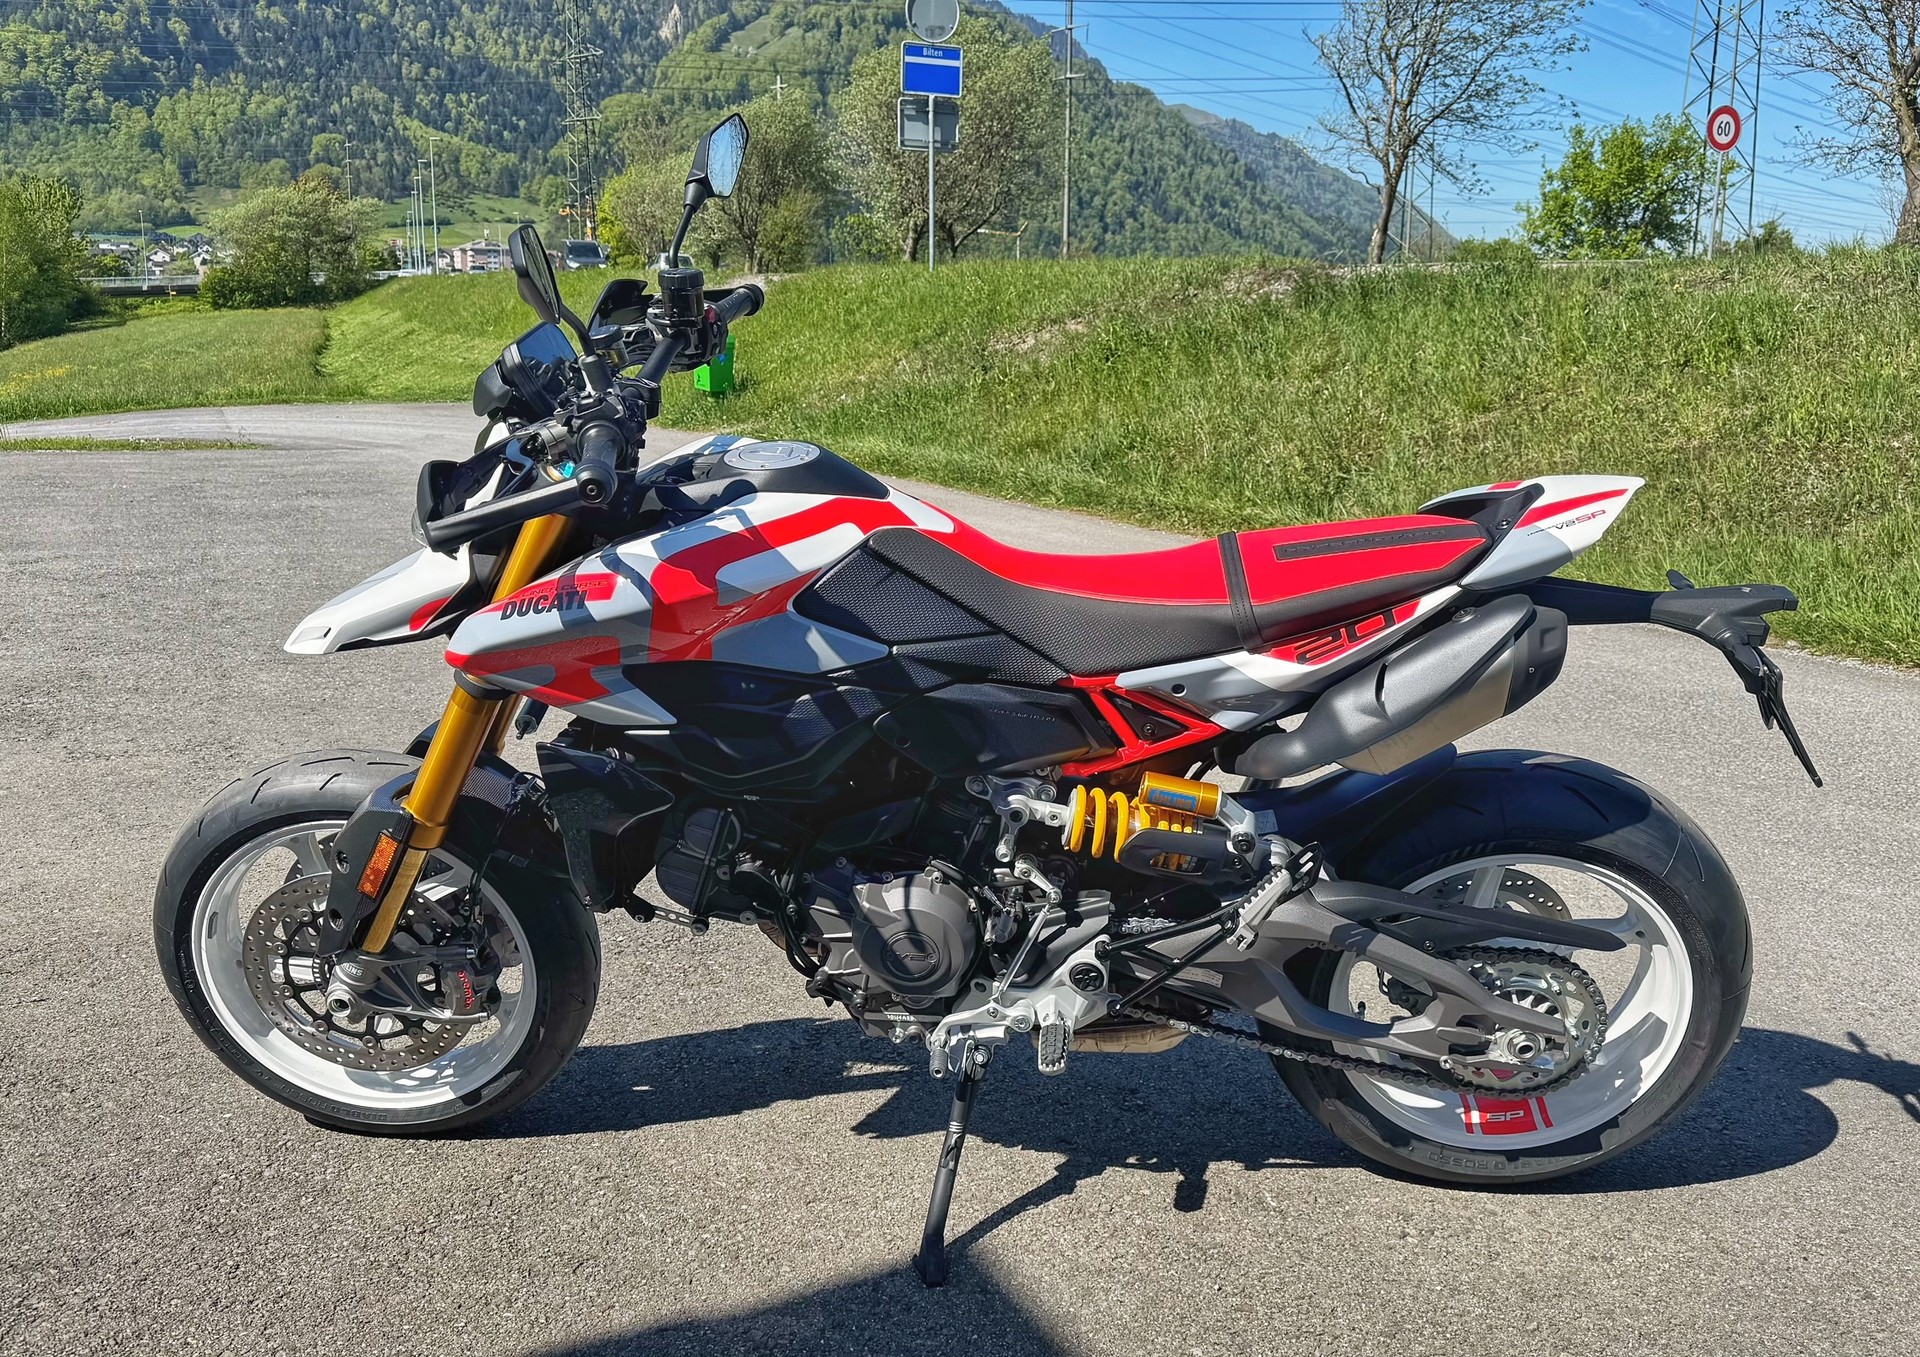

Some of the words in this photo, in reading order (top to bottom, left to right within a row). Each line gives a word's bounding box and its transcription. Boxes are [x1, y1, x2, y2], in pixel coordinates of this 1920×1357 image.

[922, 47, 943, 57] Bilten
[1716, 120, 1731, 137] 60
[500, 589, 588, 621] DUCATI
[1487, 1110, 1525, 1122] SP
